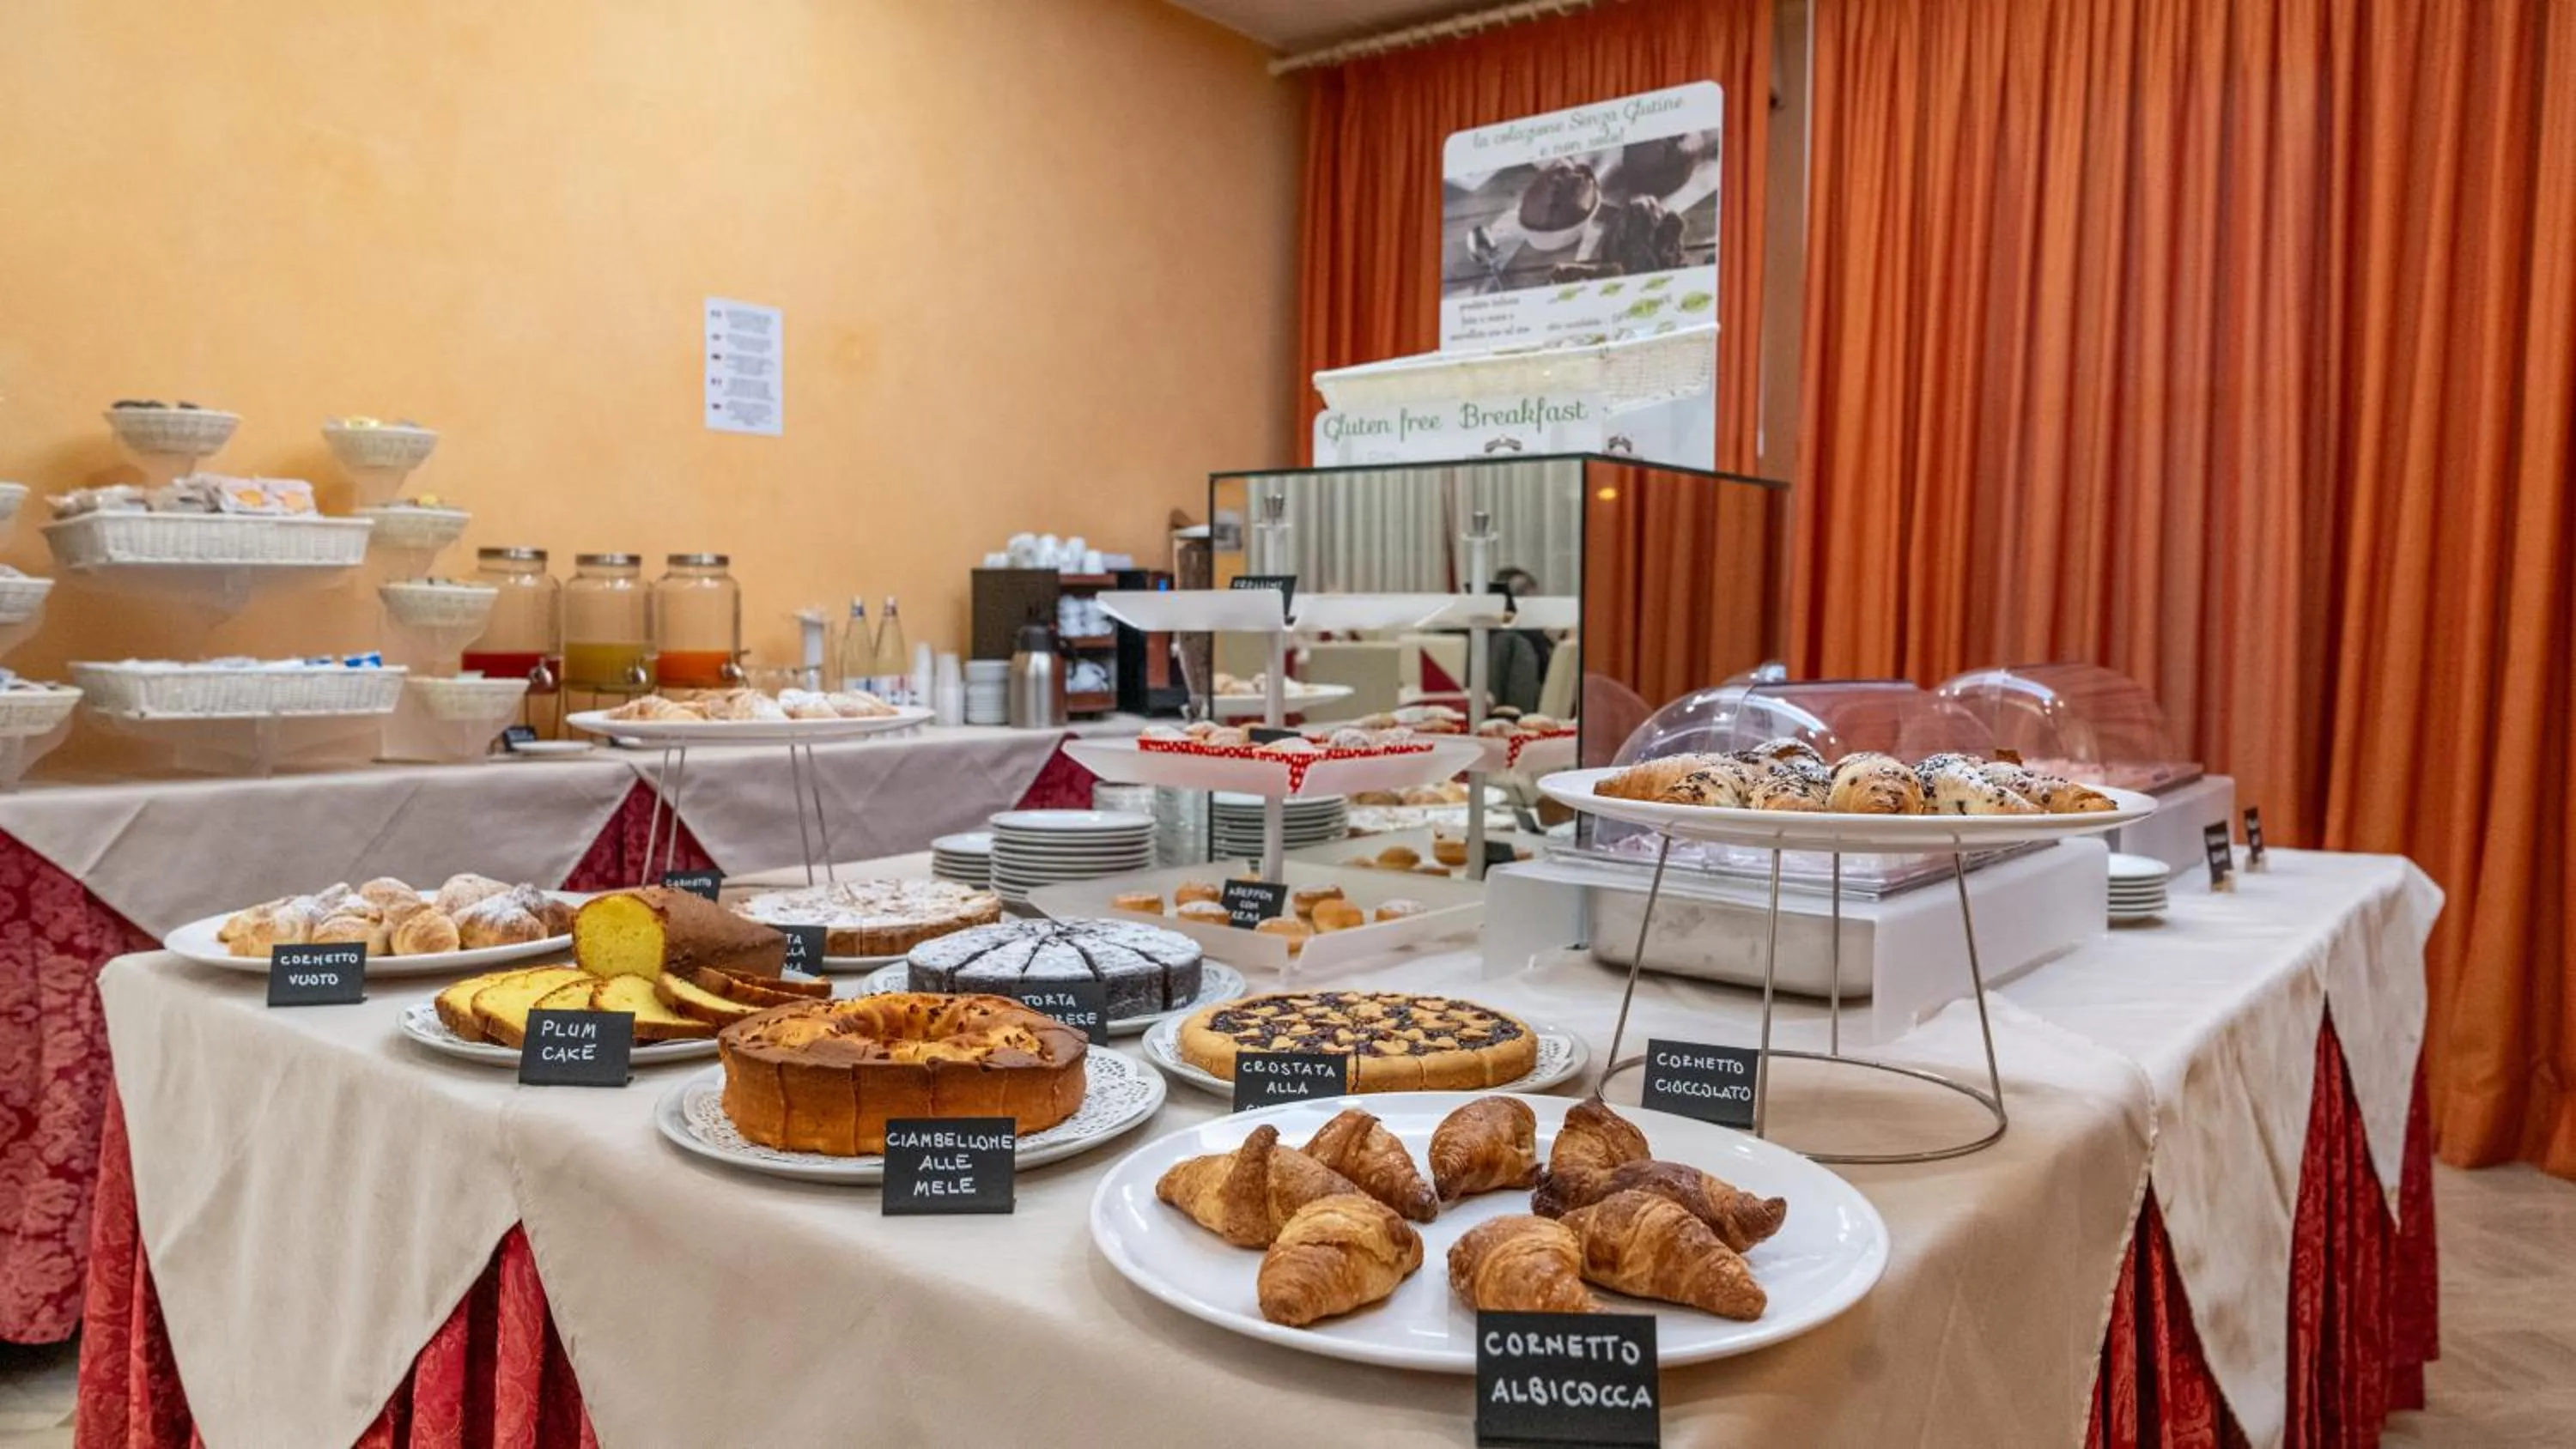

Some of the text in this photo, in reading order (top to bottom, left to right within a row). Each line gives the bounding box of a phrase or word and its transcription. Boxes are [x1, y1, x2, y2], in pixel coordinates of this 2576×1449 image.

[1323, 397, 1588, 442] Gluten free Breakfast
[280, 953, 358, 966] CORNETTO
[289, 973, 338, 986] VUOTO
[1021, 993, 1076, 1008] TORTA
[541, 1019, 597, 1040] PLUM
[542, 1044, 597, 1063] CAKE
[1656, 1052, 1744, 1075] CORNETTO
[1242, 1060, 1336, 1078] CROSTATA
[1266, 1081, 1309, 1094] ALLA
[1655, 1078, 1752, 1101] CIOCCOLATO
[886, 1131, 1014, 1151] CIAMBELLONE
[918, 1154, 973, 1172] ALLE
[914, 1177, 976, 1197] MELE
[1485, 1331, 1641, 1366] CORNETTO
[1491, 1376, 1653, 1410] ALBICOCCA
